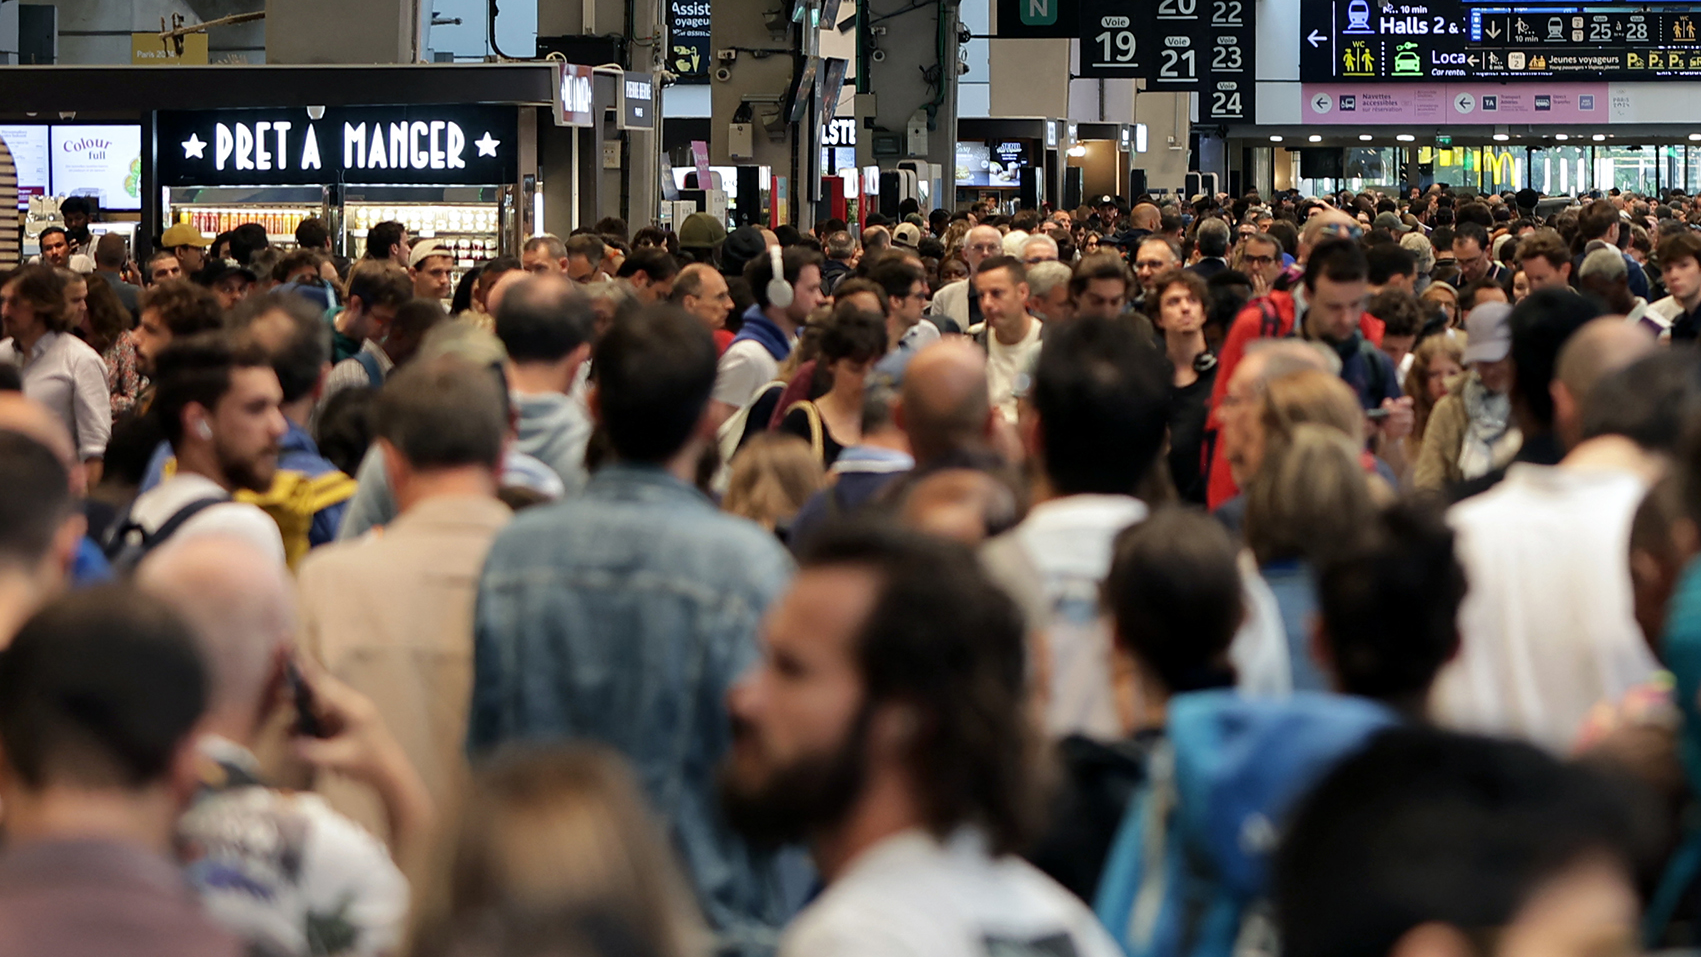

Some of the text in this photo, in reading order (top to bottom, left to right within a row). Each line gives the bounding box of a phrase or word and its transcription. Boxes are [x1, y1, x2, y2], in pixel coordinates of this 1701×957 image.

[1213, 2, 1242, 22] 22
[1380, 17, 1458, 34] Halls 2 &
[1096, 31, 1136, 61] 19
[1160, 50, 1195, 76] 21
[1212, 46, 1243, 68] 23
[1549, 56, 1619, 66] Jeunes voyageurs
[1212, 92, 1242, 113] 24
[63, 137, 112, 153] Colour
[88, 150, 106, 160] full
[216, 121, 465, 170] PRET A MANGER
